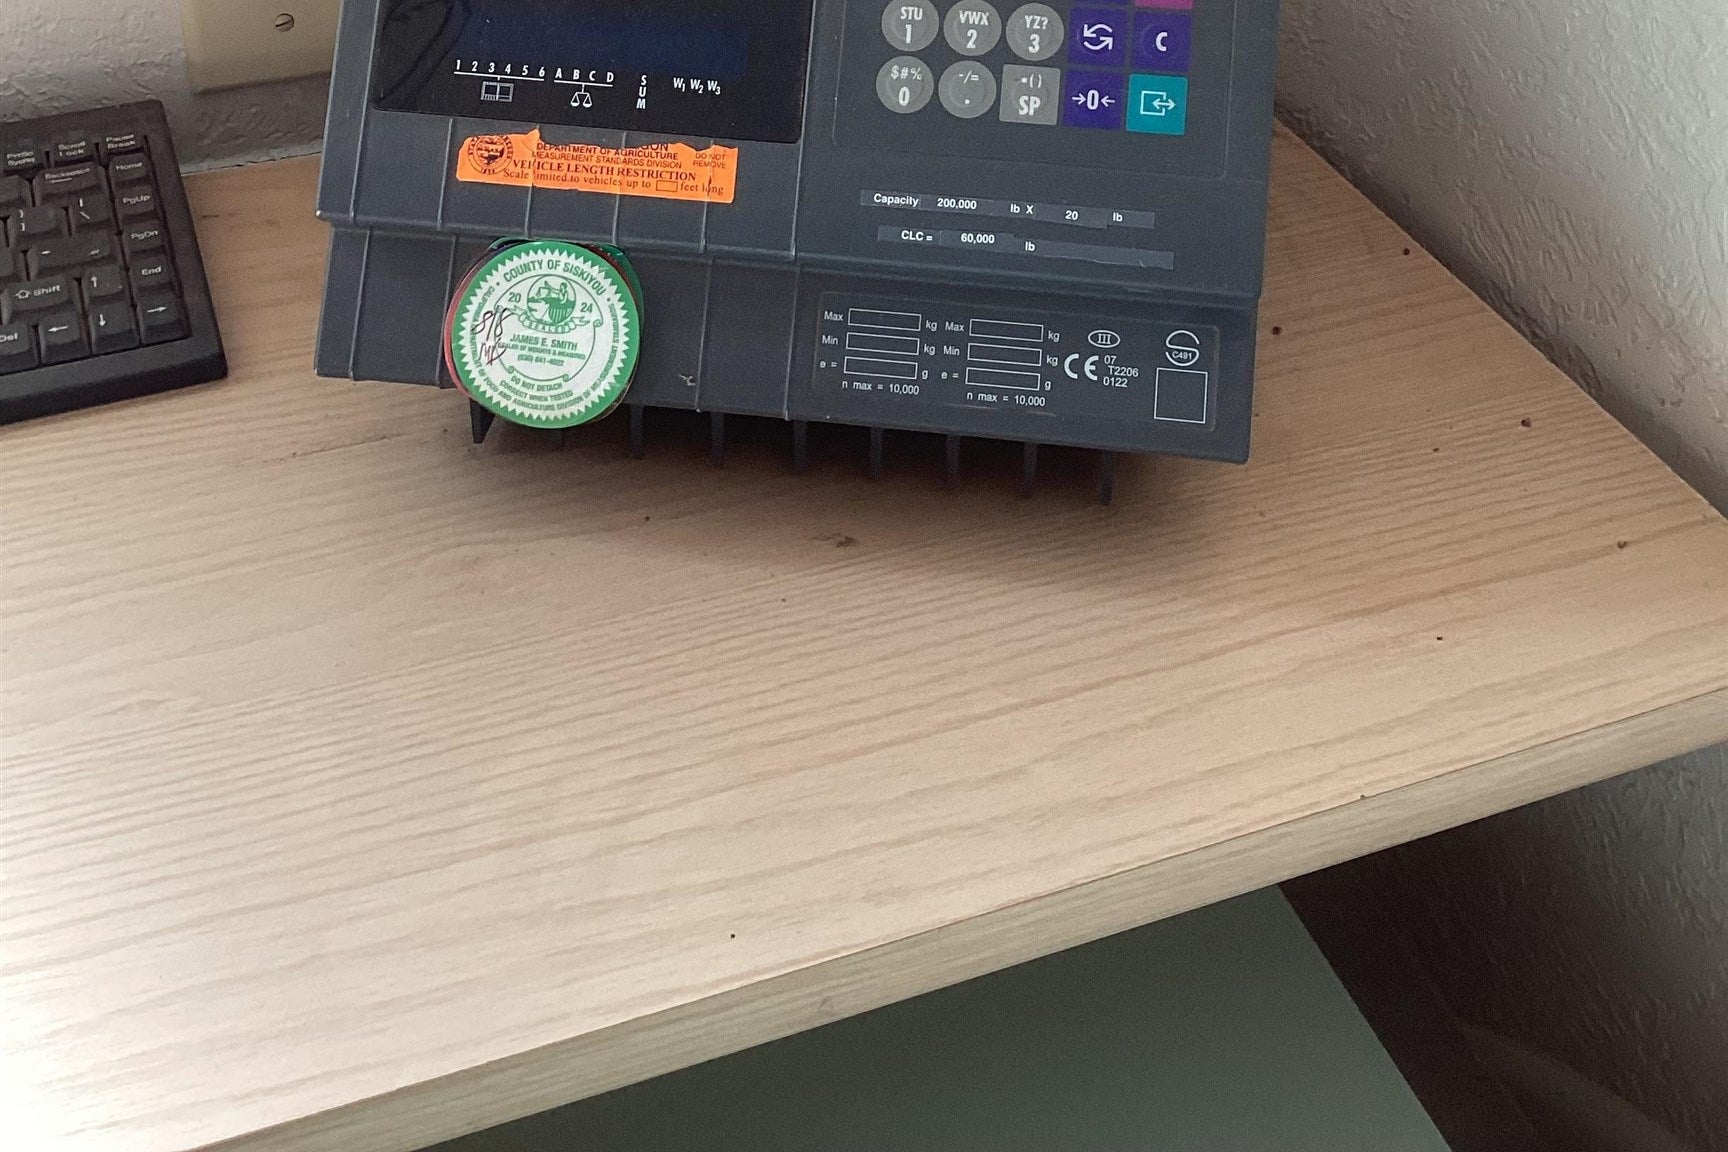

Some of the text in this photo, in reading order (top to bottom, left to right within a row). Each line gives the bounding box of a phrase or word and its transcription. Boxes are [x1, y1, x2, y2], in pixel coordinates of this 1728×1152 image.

[900, 6, 923, 21] STU
[959, 10, 990, 26] VWX
[1024, 14, 1049, 30] YZ?
[966, 29, 977, 49] 2
[1028, 34, 1040, 54] 3
[1155, 32, 1168, 52] C
[898, 87, 910, 106] 0
[1018, 96, 1041, 115] SP
[537, 142, 597, 154] DEPARTMENT
[614, 147, 679, 160] AGRICULTURE
[115, 161, 143, 171] Home
[532, 152, 683, 169] MEASUREMENT STANDARDS DIVISION
[693, 161, 726, 169] REMOVE
[513, 159, 697, 182] VEHICLE LENGTH RESTRICTION
[503, 168, 529, 179] Scale
[570, 174, 580, 183] to
[584, 175, 622, 187] vehicles
[626, 180, 638, 189] up
[642, 179, 651, 188] to
[681, 182, 698, 192] feet
[123, 195, 151, 205] PgUp
[873, 193, 1123, 223] Capacity 200,000 lb X 20 lb
[131, 230, 158, 240] PgDn
[901, 230, 1036, 252] CLC 60,000 lb
[141, 266, 162, 276] End
[503, 259, 607, 296] COUNTY OF SISKIYOU
[508, 292, 522, 303] 20
[580, 302, 593, 314] 24
[824, 311, 844, 322] Max
[925, 320, 938, 332] kg
[945, 321, 965, 332] Max
[510, 333, 539, 345] JAMES
[551, 339, 578, 351] SMITH
[822, 334, 839, 345] Min
[1047, 330, 1060, 342] kg
[923, 343, 936, 356] kg
[943, 345, 960, 356] Min
[1046, 354, 1059, 367] kg
[1104, 355, 1117, 365] 07
[1108, 365, 1139, 378] T2206
[511, 375, 563, 392] DO NOT DETACH
[853, 382, 920, 395] max 10,000
[1103, 376, 1128, 388] 0122
[978, 393, 1046, 407] max 10,000
